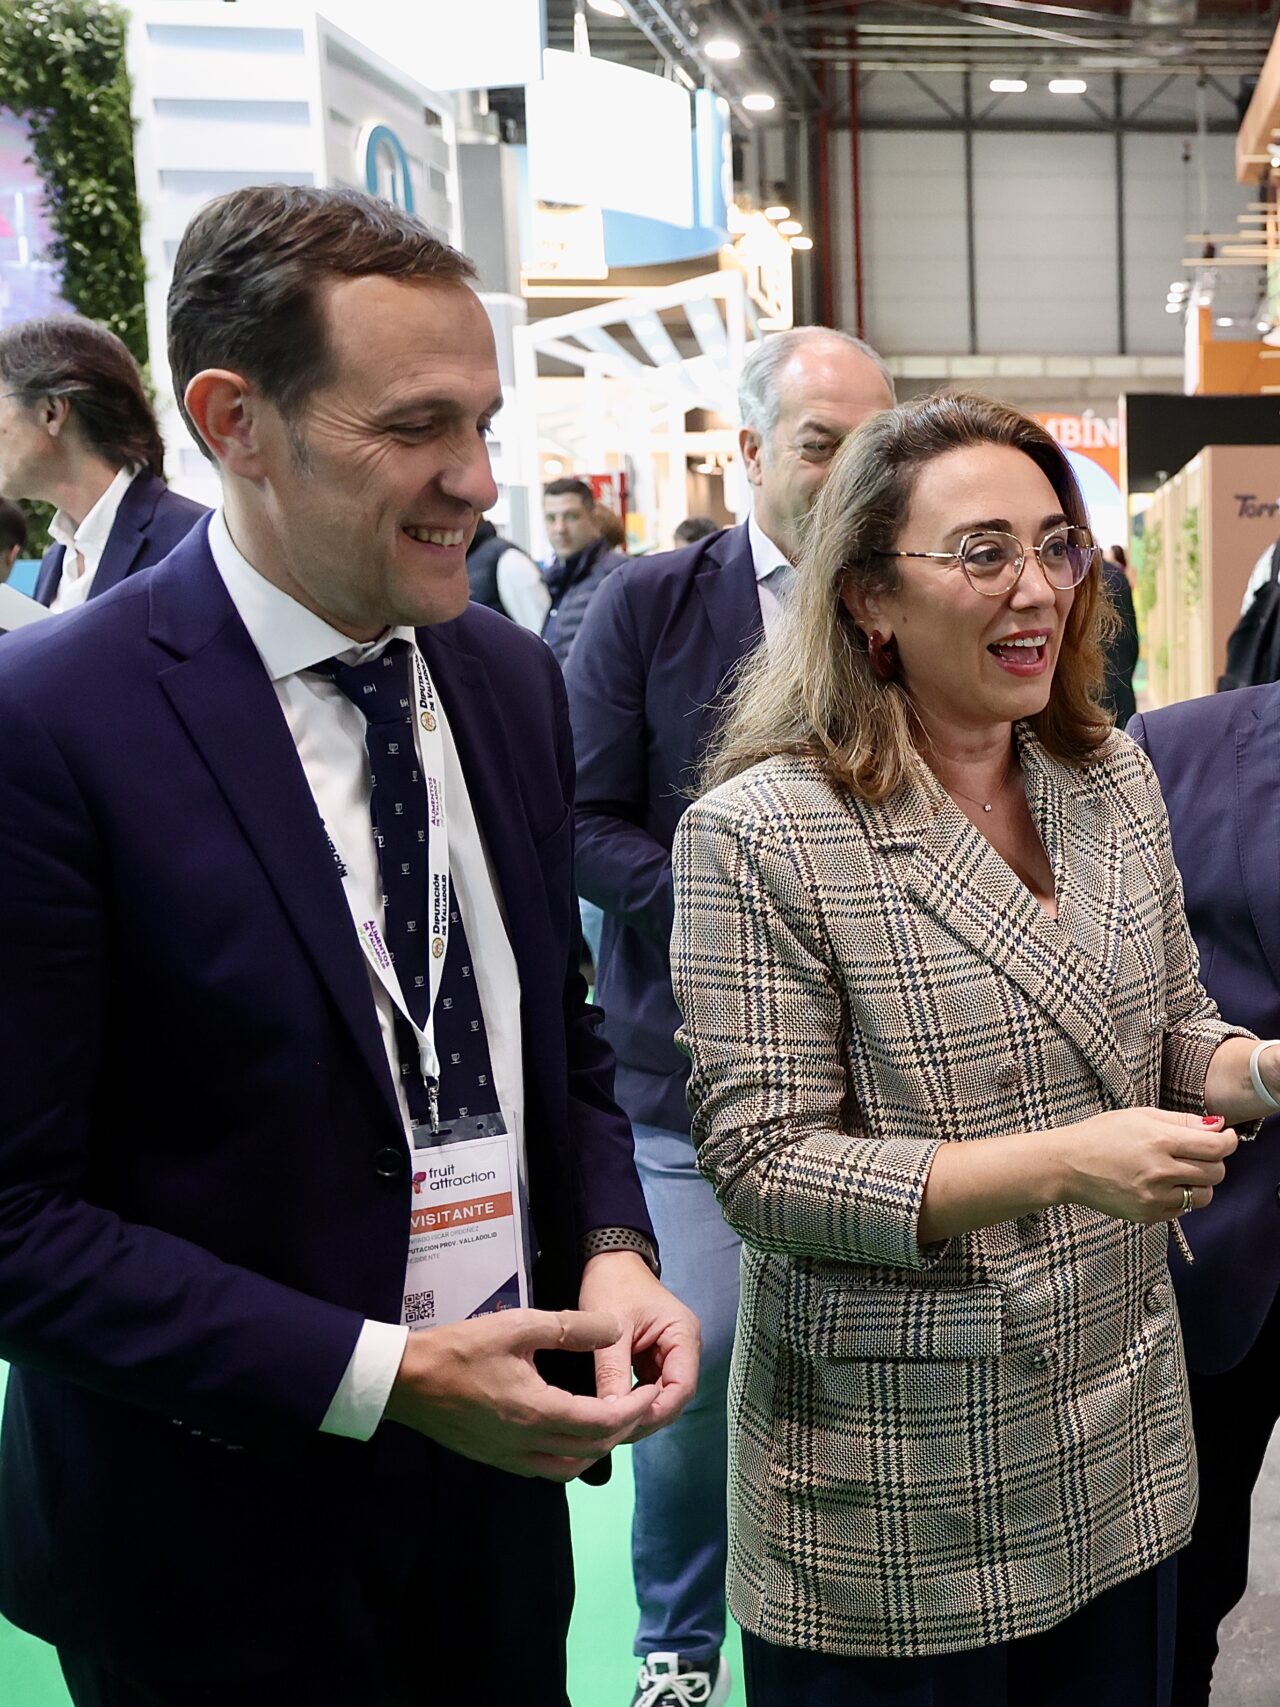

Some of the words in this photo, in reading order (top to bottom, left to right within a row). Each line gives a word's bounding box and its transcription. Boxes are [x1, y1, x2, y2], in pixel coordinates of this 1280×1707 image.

[432, 873, 441, 935] DIPUTACIÓN
[367, 920, 391, 968] ALIMENTOS
[428, 1164, 455, 1179] fruit
[429, 1170, 497, 1191] attraction
[410, 1201, 496, 1229] VISITANTE
[459, 1231, 498, 1245] VALLADOLID
